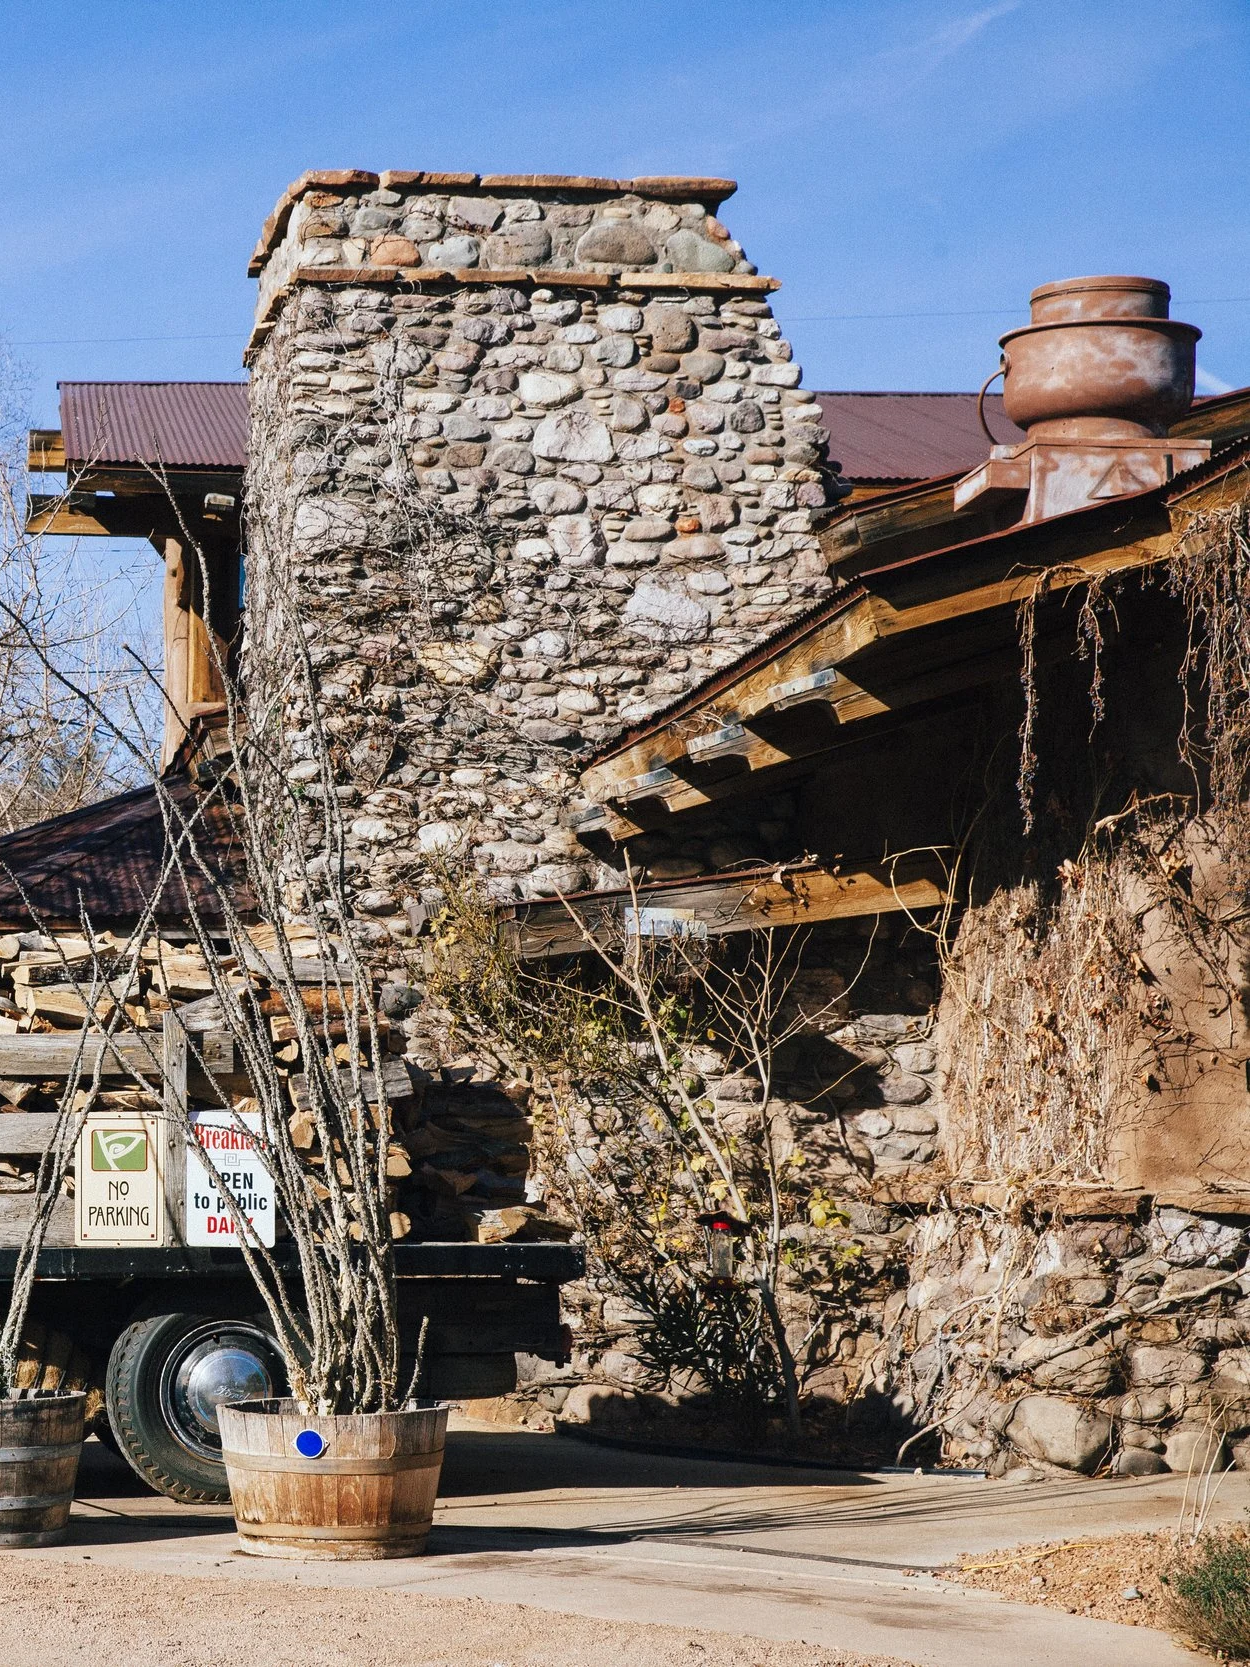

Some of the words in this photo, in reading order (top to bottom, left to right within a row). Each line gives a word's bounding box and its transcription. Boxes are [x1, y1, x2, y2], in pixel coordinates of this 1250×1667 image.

[194, 1123, 267, 1150] Breakfa
[193, 1192, 210, 1210] to
[216, 1193, 268, 1214] pblic
[88, 1206, 150, 1226] PARKING
[207, 1216, 254, 1234] DAI
